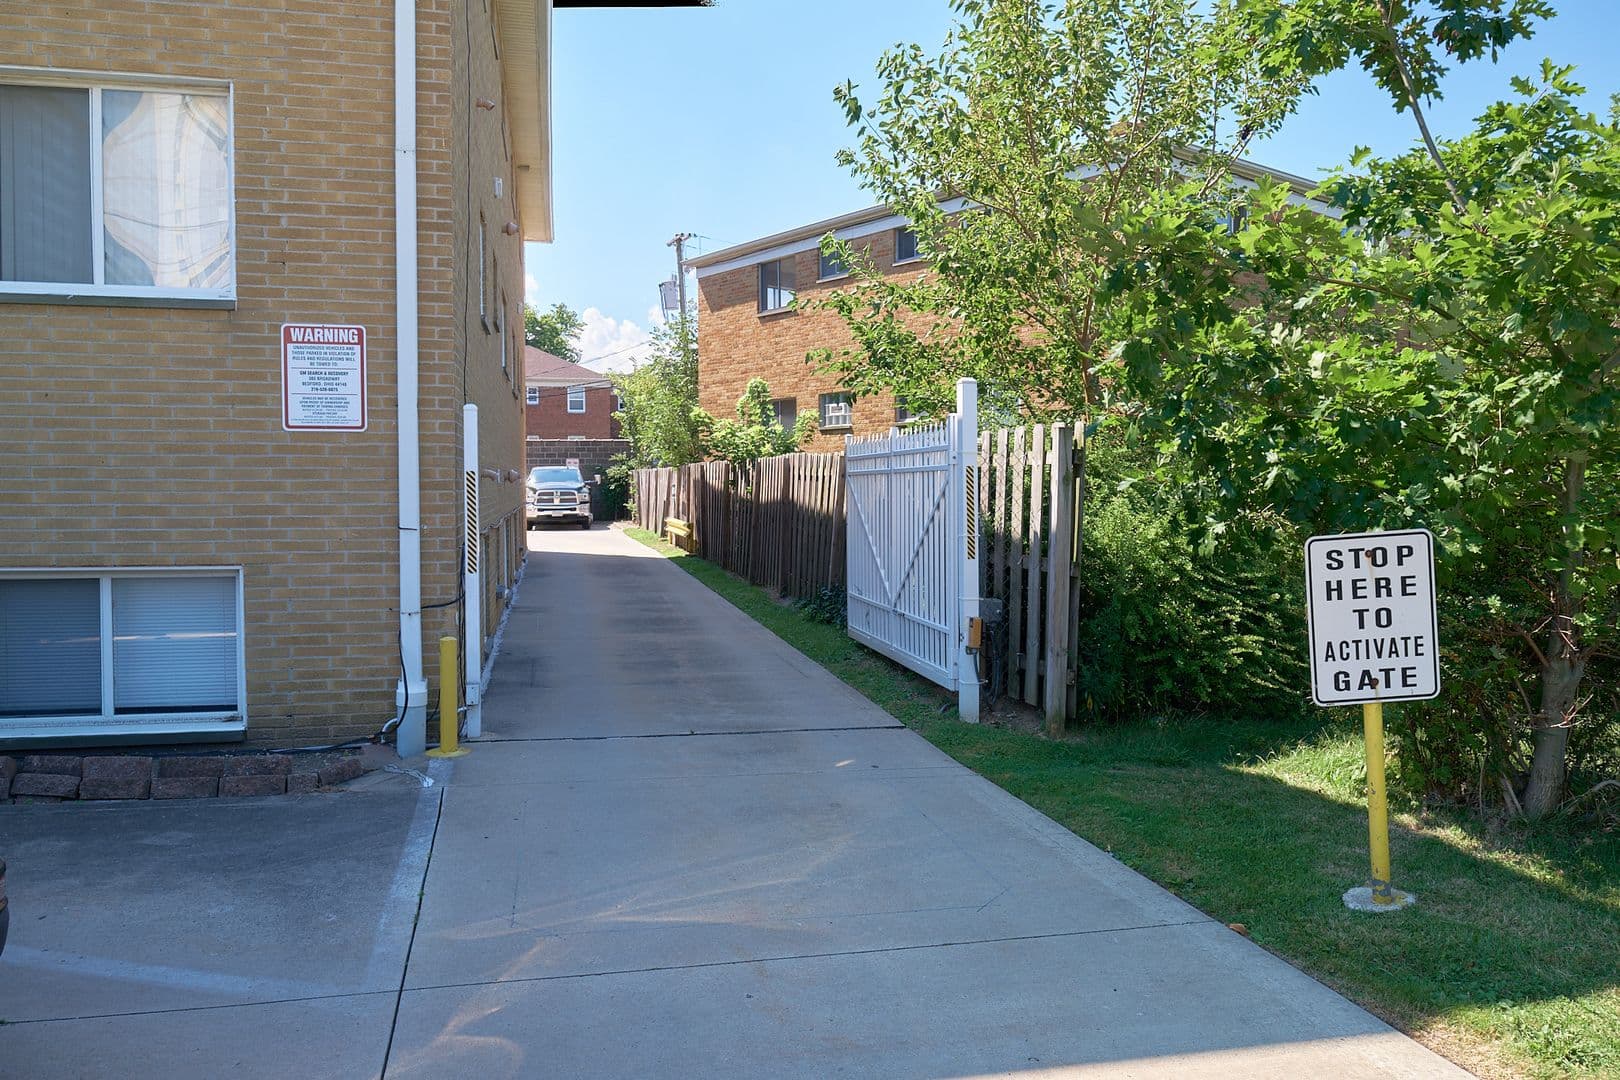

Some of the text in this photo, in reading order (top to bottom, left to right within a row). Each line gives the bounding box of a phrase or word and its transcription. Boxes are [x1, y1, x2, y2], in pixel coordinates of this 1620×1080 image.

[290, 328, 358, 342] WARNING
[1326, 545, 1414, 570] STOP
[1326, 576, 1416, 601] HERE
[1352, 608, 1392, 630] TO
[1324, 636, 1424, 662] ACTIVATE
[1334, 667, 1418, 692] GATE
